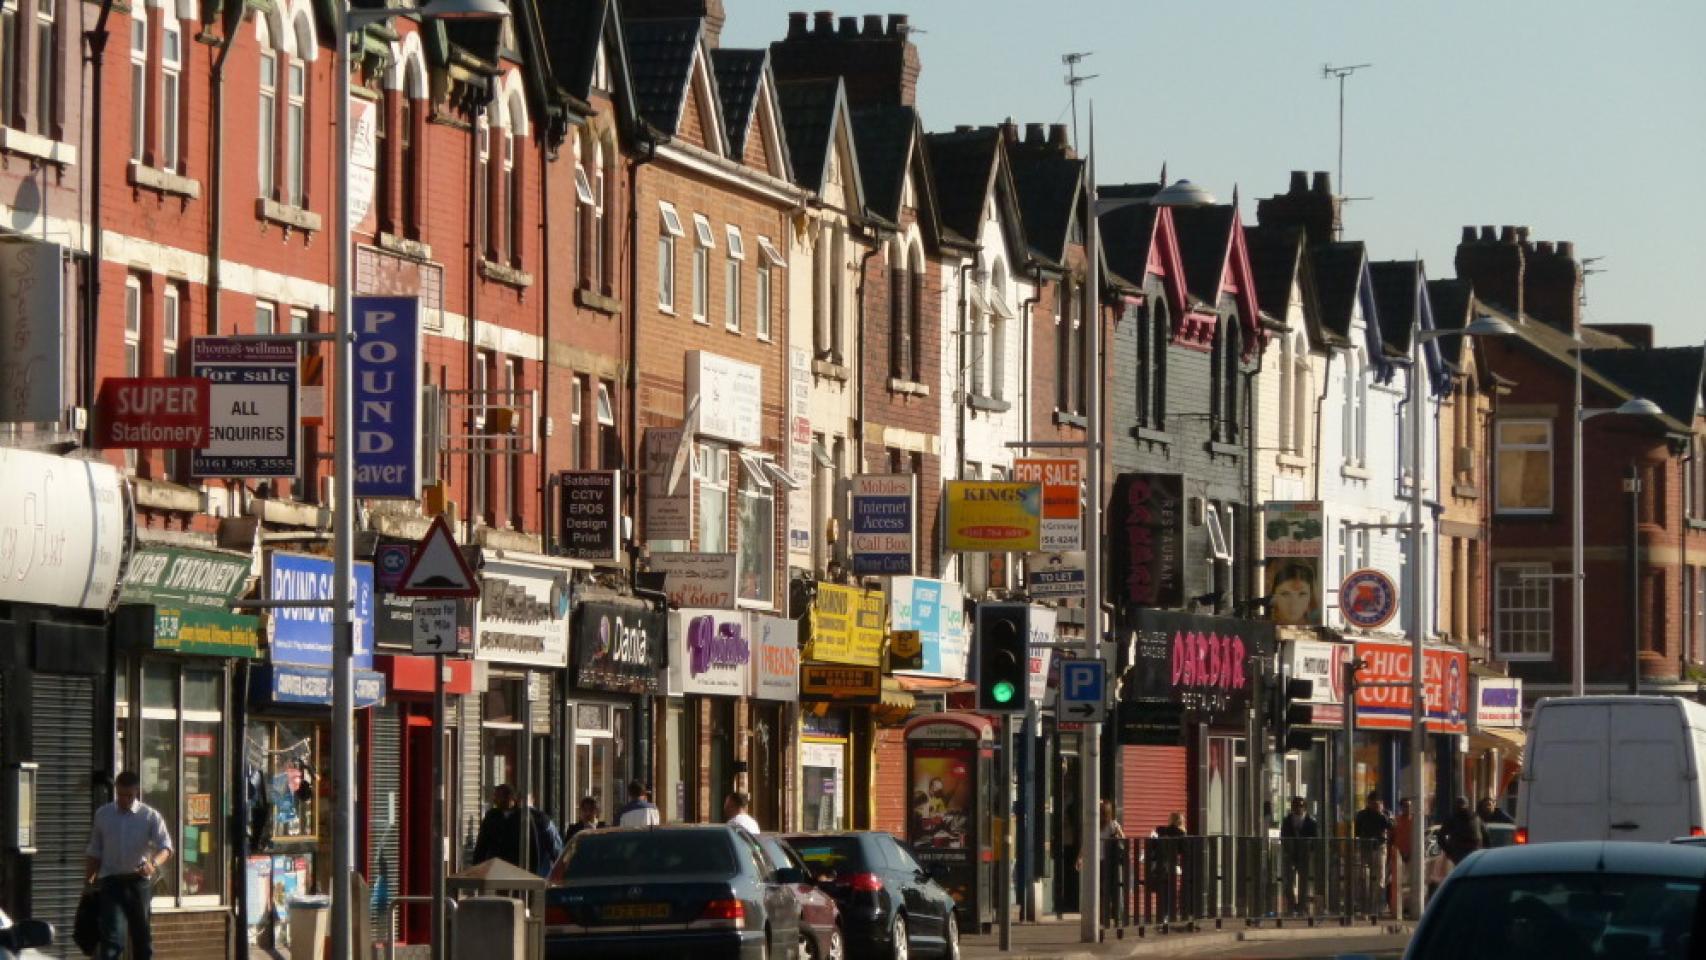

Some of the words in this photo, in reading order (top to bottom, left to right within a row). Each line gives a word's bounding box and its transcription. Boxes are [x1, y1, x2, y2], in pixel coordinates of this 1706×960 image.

[201, 367, 236, 382] for
[243, 367, 290, 382] sale
[358, 310, 398, 454] POUND
[117, 386, 198, 414] SUPER
[231, 401, 259, 416] ALL
[112, 421, 203, 446] Stationery
[352, 458, 407, 484] aver
[1017, 464, 1042, 481] FOR
[1045, 464, 1078, 486] SALE
[563, 475, 610, 486] Satellite
[860, 479, 907, 492] Mobiles
[571, 490, 604, 500] CCTV
[963, 486, 1027, 502] KINGS
[569, 503, 604, 514] EPOS
[857, 500, 907, 515] Internet
[566, 517, 607, 532] Design
[862, 515, 905, 529] Access
[572, 532, 601, 544] Print
[856, 534, 881, 549] Call
[885, 536, 908, 549] Box
[164, 555, 247, 595] STATIONERY
[274, 568, 317, 622] POUND
[690, 591, 729, 606] 6607
[1172, 630, 1247, 689] DARBAR
[1361, 650, 1442, 679] CHICEN
[1072, 668, 1093, 697] P
[1360, 678, 1442, 707] COTTGE
